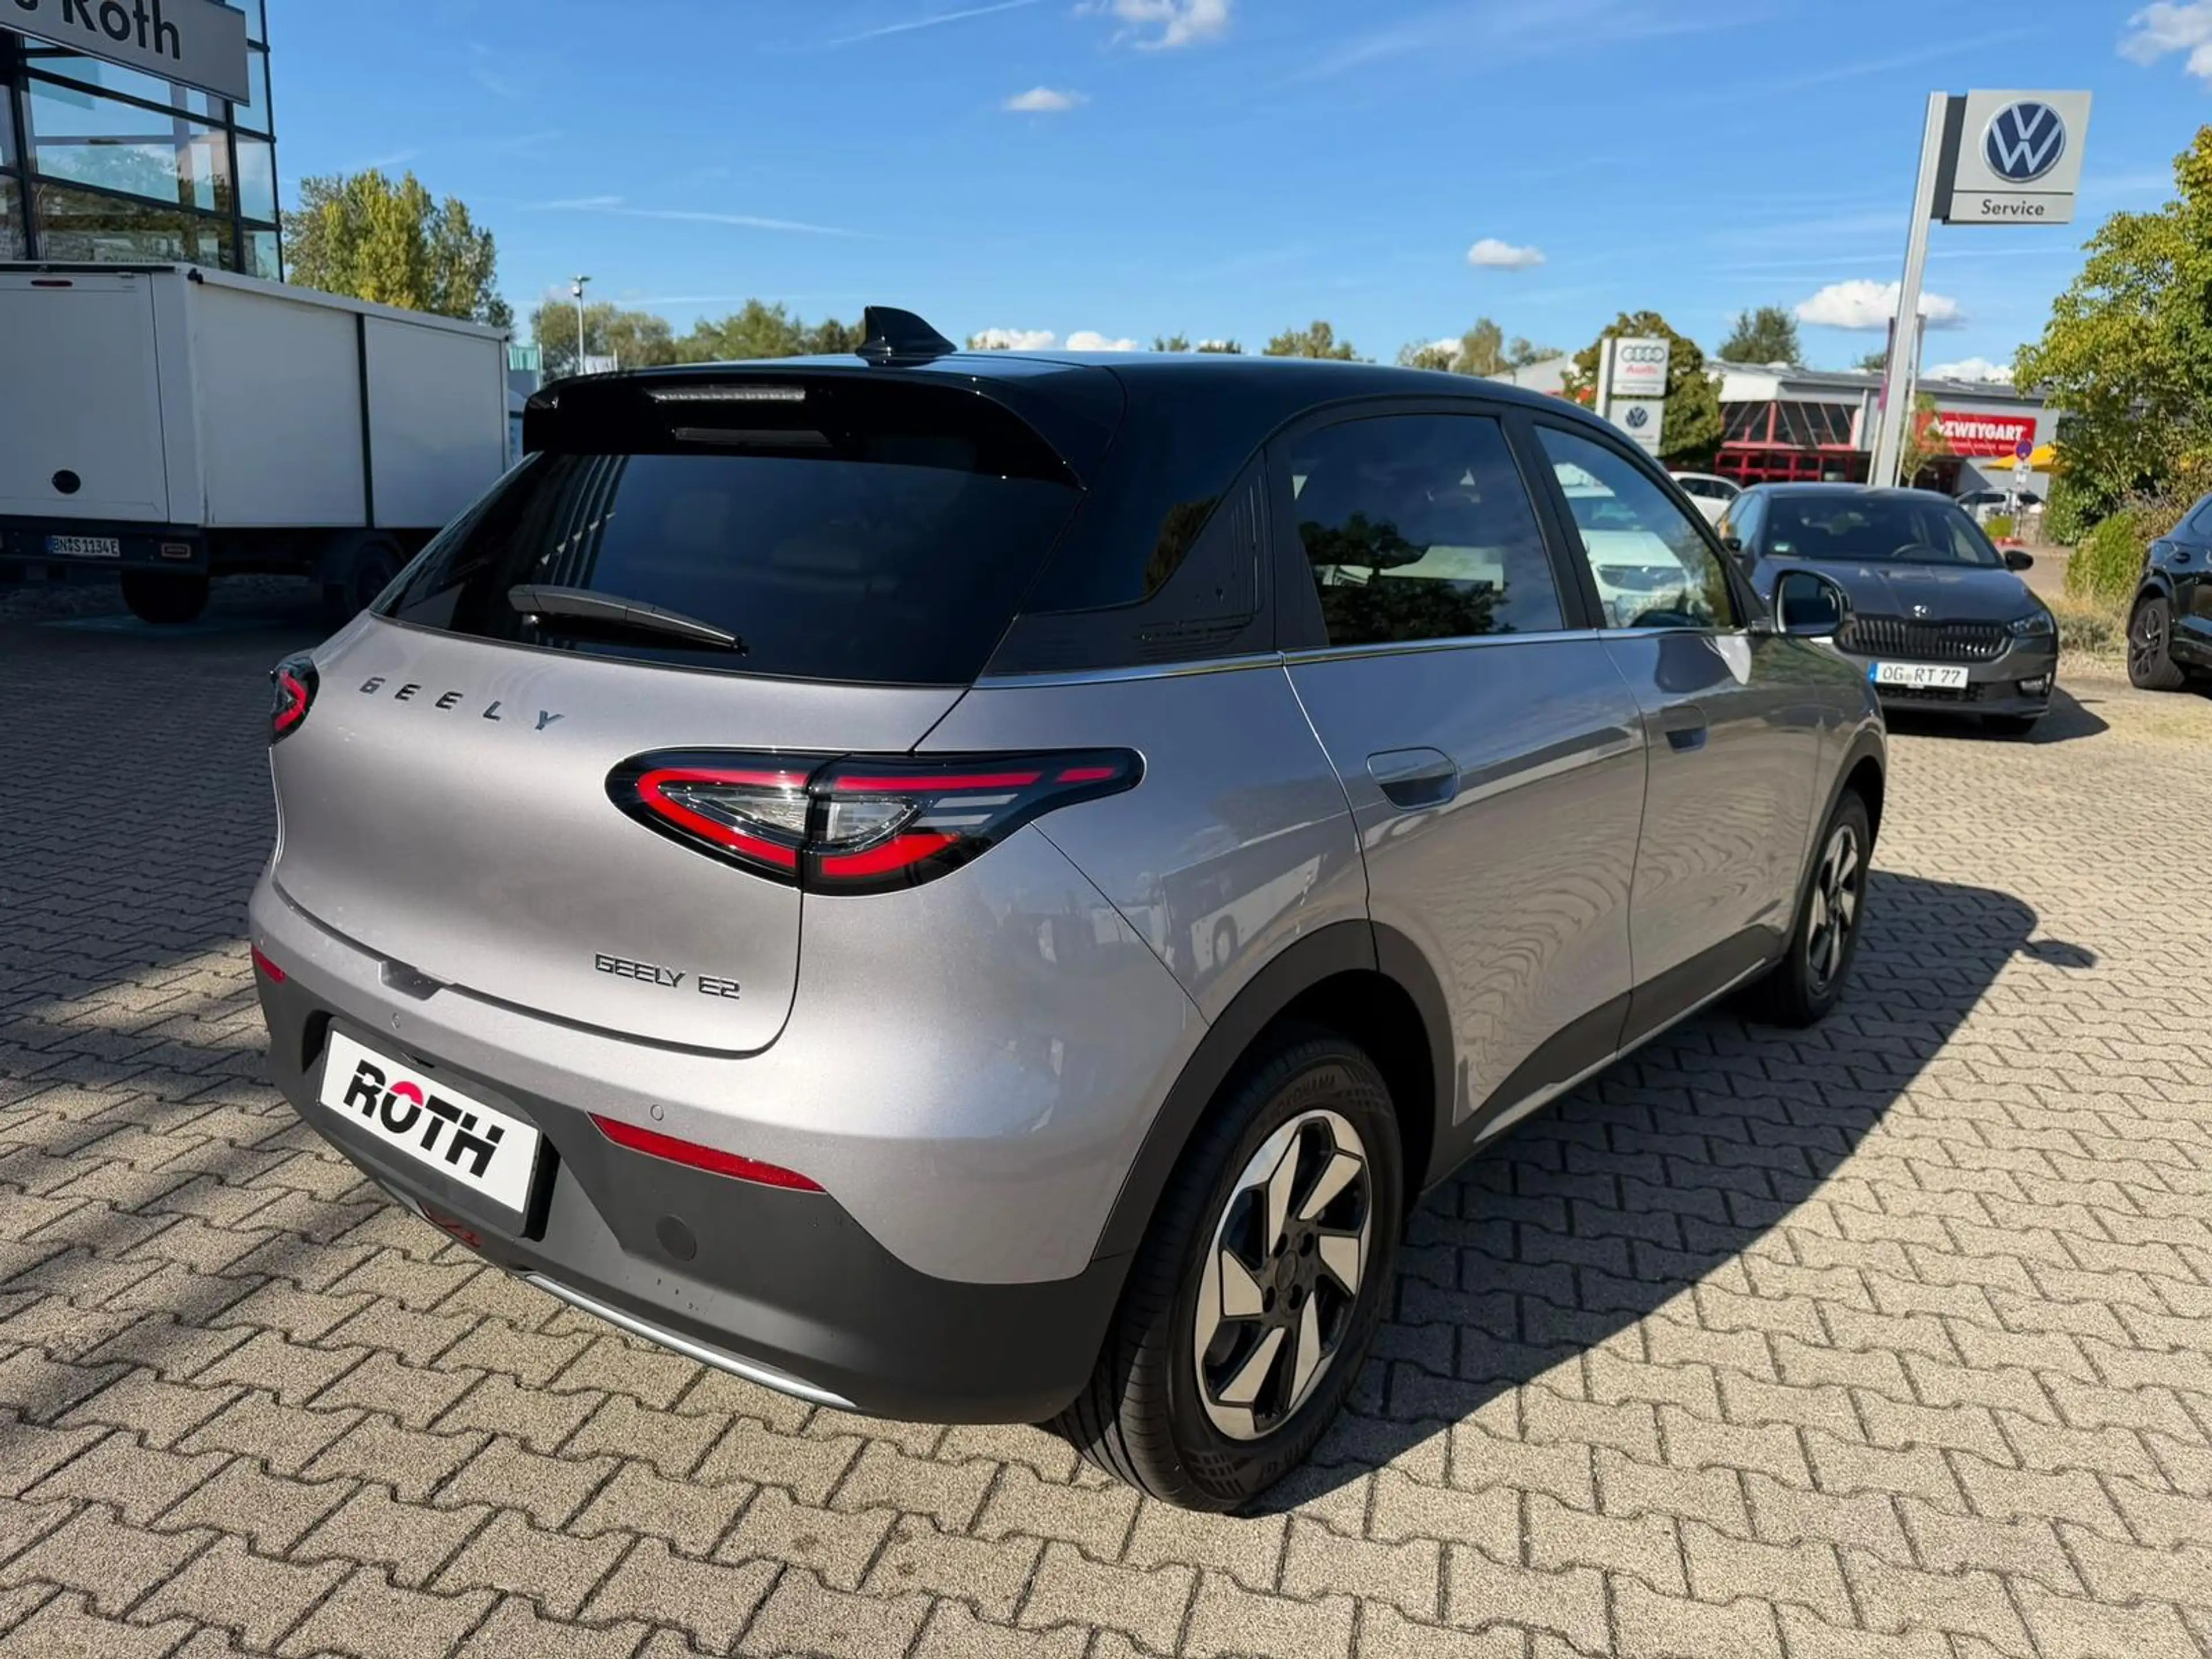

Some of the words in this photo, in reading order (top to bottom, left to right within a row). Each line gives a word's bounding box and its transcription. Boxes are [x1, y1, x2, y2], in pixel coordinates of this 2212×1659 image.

[1986, 101, 2063, 177] VW
[1981, 199, 2044, 215] Service
[1943, 421, 2024, 441] ZWEYGART
[1883, 666, 1904, 681] OG
[1915, 668, 1936, 682] RT
[1941, 669, 1961, 684] 77
[359, 677, 565, 731] GEELY
[595, 952, 687, 988] GEELY
[698, 974, 741, 1000] E2
[343, 1059, 505, 1178] ROTH
